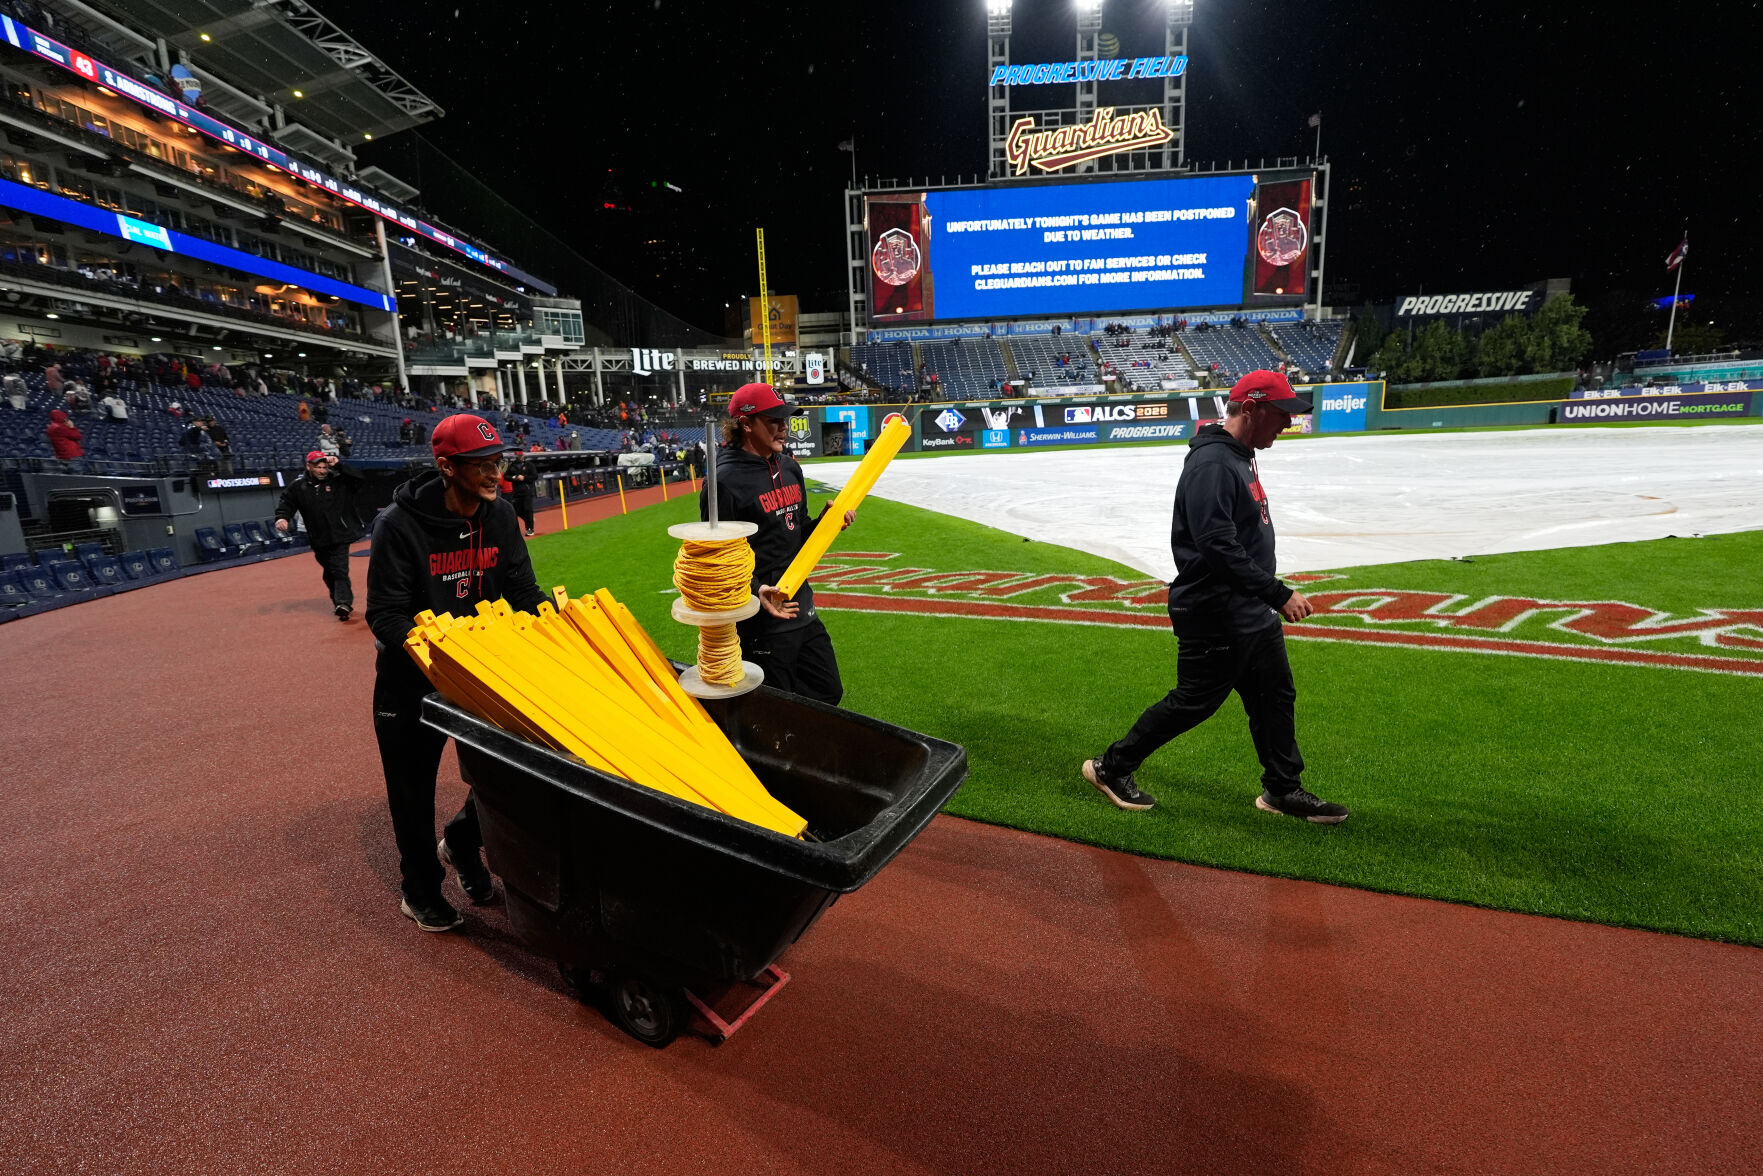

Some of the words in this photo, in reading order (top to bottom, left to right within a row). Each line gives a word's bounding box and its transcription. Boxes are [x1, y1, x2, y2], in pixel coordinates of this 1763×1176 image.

[76, 57, 94, 77] 43
[989, 59, 1129, 86] PROGRESSIVE
[1128, 55, 1189, 79] FIELD
[1006, 106, 1174, 176] Guardians
[946, 217, 1034, 233] UNFORTUNATELY
[1034, 214, 1090, 228] TONIGHT'S
[1090, 212, 1121, 225] GAME
[1121, 211, 1144, 224] HAS
[1144, 210, 1172, 223] BEEN
[1172, 207, 1236, 221] POSTPONED
[1044, 231, 1066, 243] DUE
[1066, 230, 1081, 242] TO
[1081, 227, 1135, 241] WEATHER.
[971, 263, 1010, 276] PLEASE
[1010, 261, 1045, 273] REACH
[1046, 260, 1068, 272] OUT
[1068, 259, 1083, 271] TO
[1083, 258, 1105, 270] FAN
[1105, 255, 1156, 269] SERVICES
[1156, 255, 1171, 267] OR
[1171, 253, 1208, 266] CHECK
[974, 275, 1078, 290] CLEGUARDIANS.COM
[1078, 273, 1099, 285] FOR
[1099, 271, 1131, 284] MORE
[1131, 268, 1206, 282] INFORMATION.
[1397, 290, 1534, 317] PROGRESSIVE
[1251, 310, 1299, 322] HONDA
[884, 329, 930, 340] HONDA
[943, 325, 991, 337] HONDA
[1024, 320, 1074, 333] HONDA
[631, 347, 675, 377] Lite
[692, 360, 740, 371] BREWED
[741, 360, 753, 371] IN
[722, 353, 752, 361] PROUDLY
[807, 358, 823, 369] Lite
[1322, 395, 1367, 413] meijer
[1679, 403, 1745, 414] MORTGAGE
[1091, 405, 1136, 422] ALCS
[1136, 406, 1168, 417] 2026
[477, 423, 495, 441] C
[790, 416, 809, 432] 811
[1109, 425, 1184, 439] PROGRESSIVE
[797, 441, 815, 449] before
[922, 437, 955, 447] KeyBank
[785, 512, 795, 530] C
[429, 546, 499, 576] GUARDIANS
[456, 577, 469, 599] C
